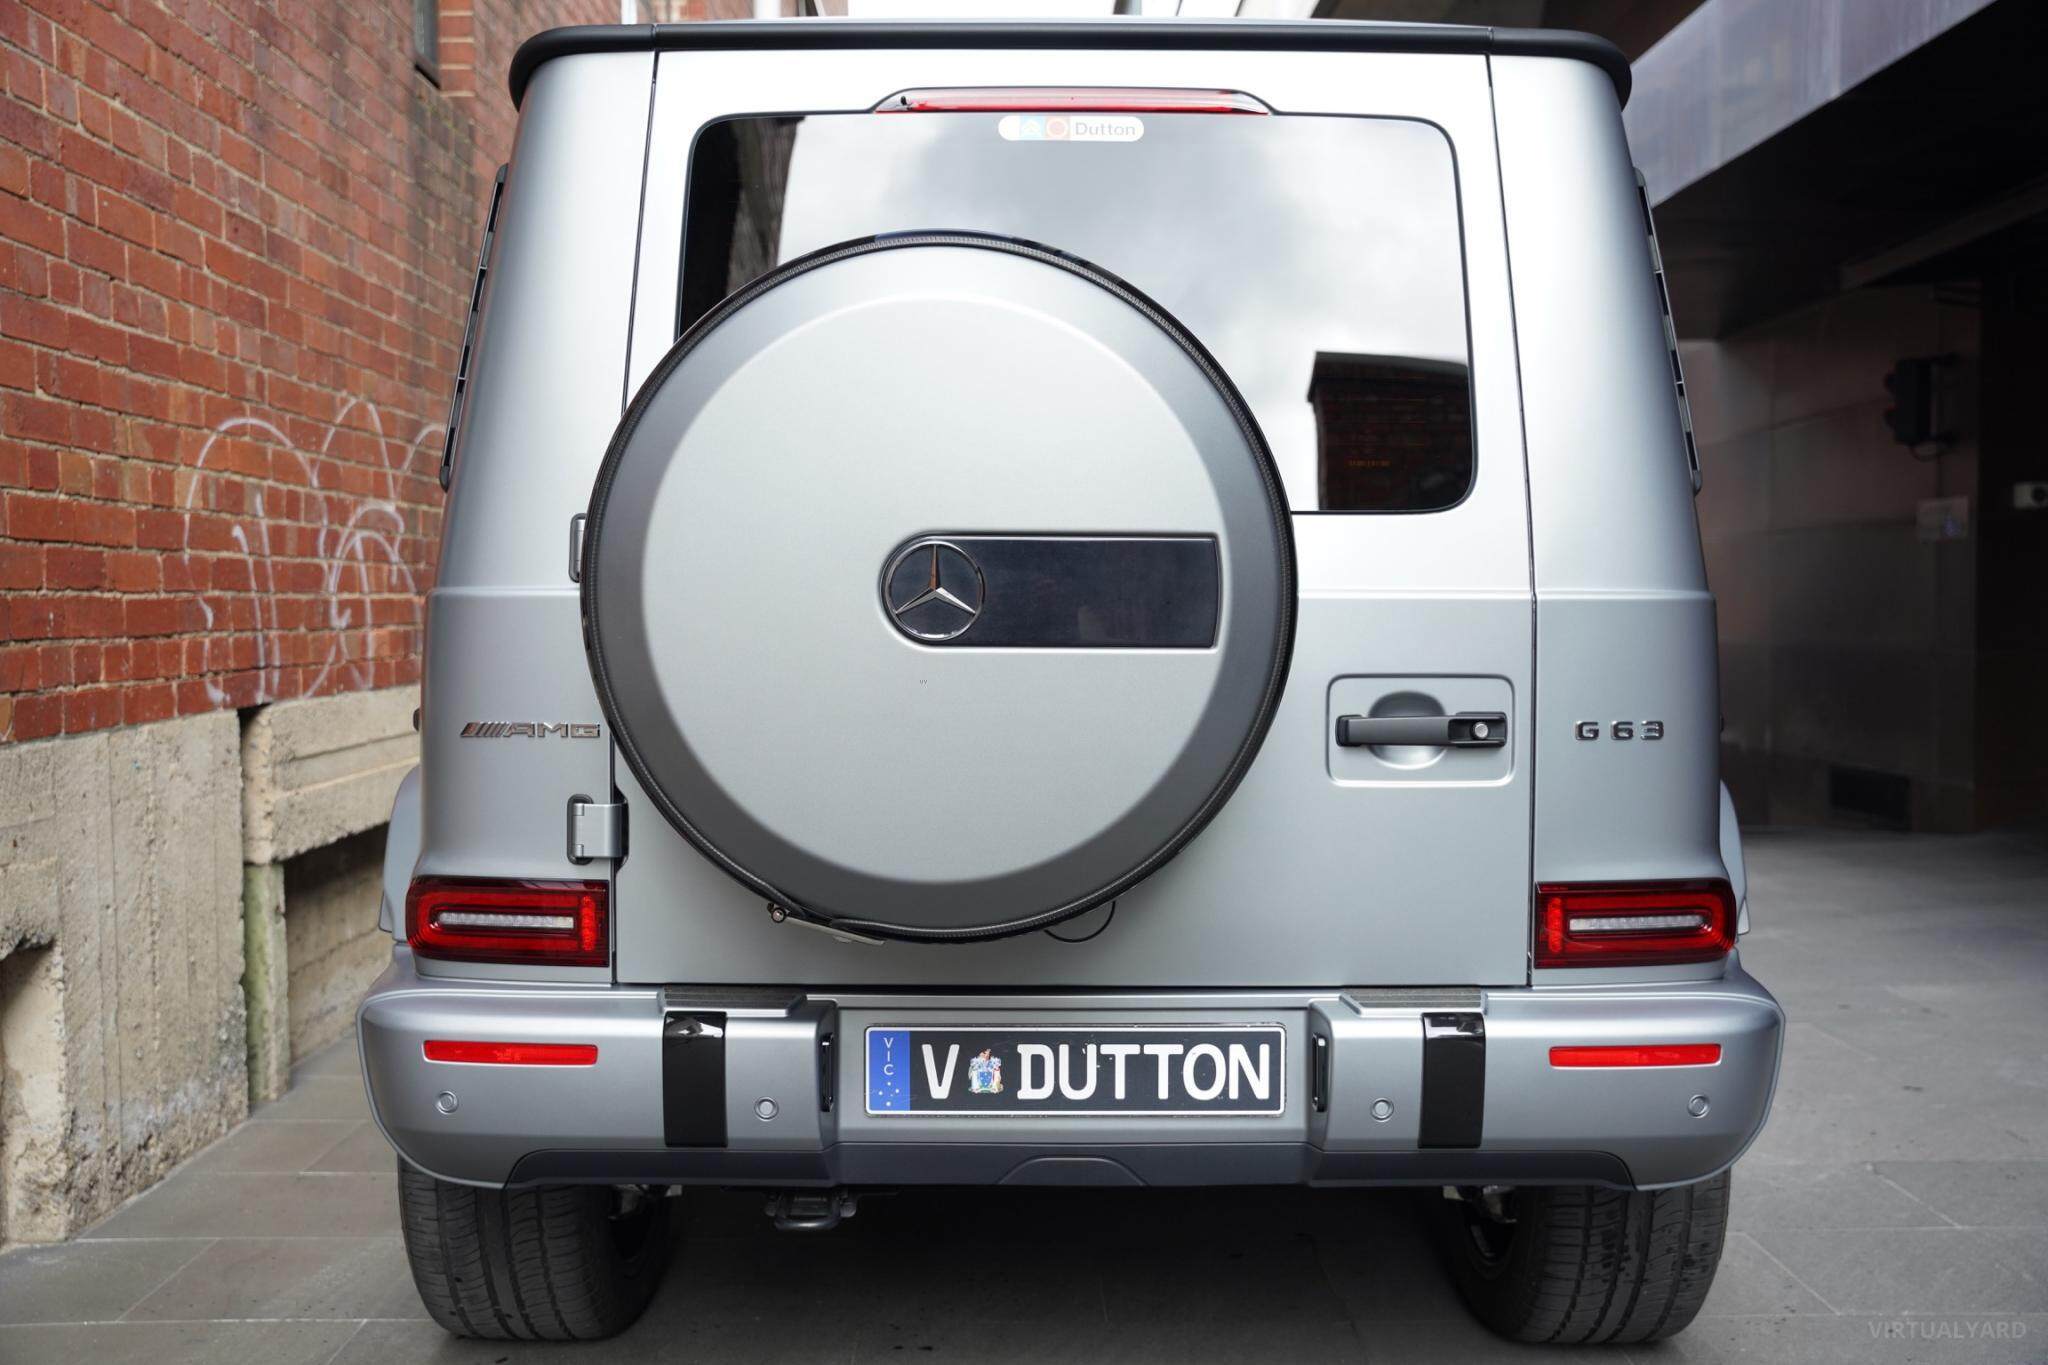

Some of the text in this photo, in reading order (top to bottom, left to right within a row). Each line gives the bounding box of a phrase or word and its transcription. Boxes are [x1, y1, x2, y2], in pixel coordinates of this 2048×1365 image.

[1075, 121, 1136, 136] Dutton
[502, 721, 600, 738] AMG
[1575, 720, 1665, 741] G 63
[883, 1037, 895, 1076] VIC
[921, 1043, 1271, 1101] V DUTTON
